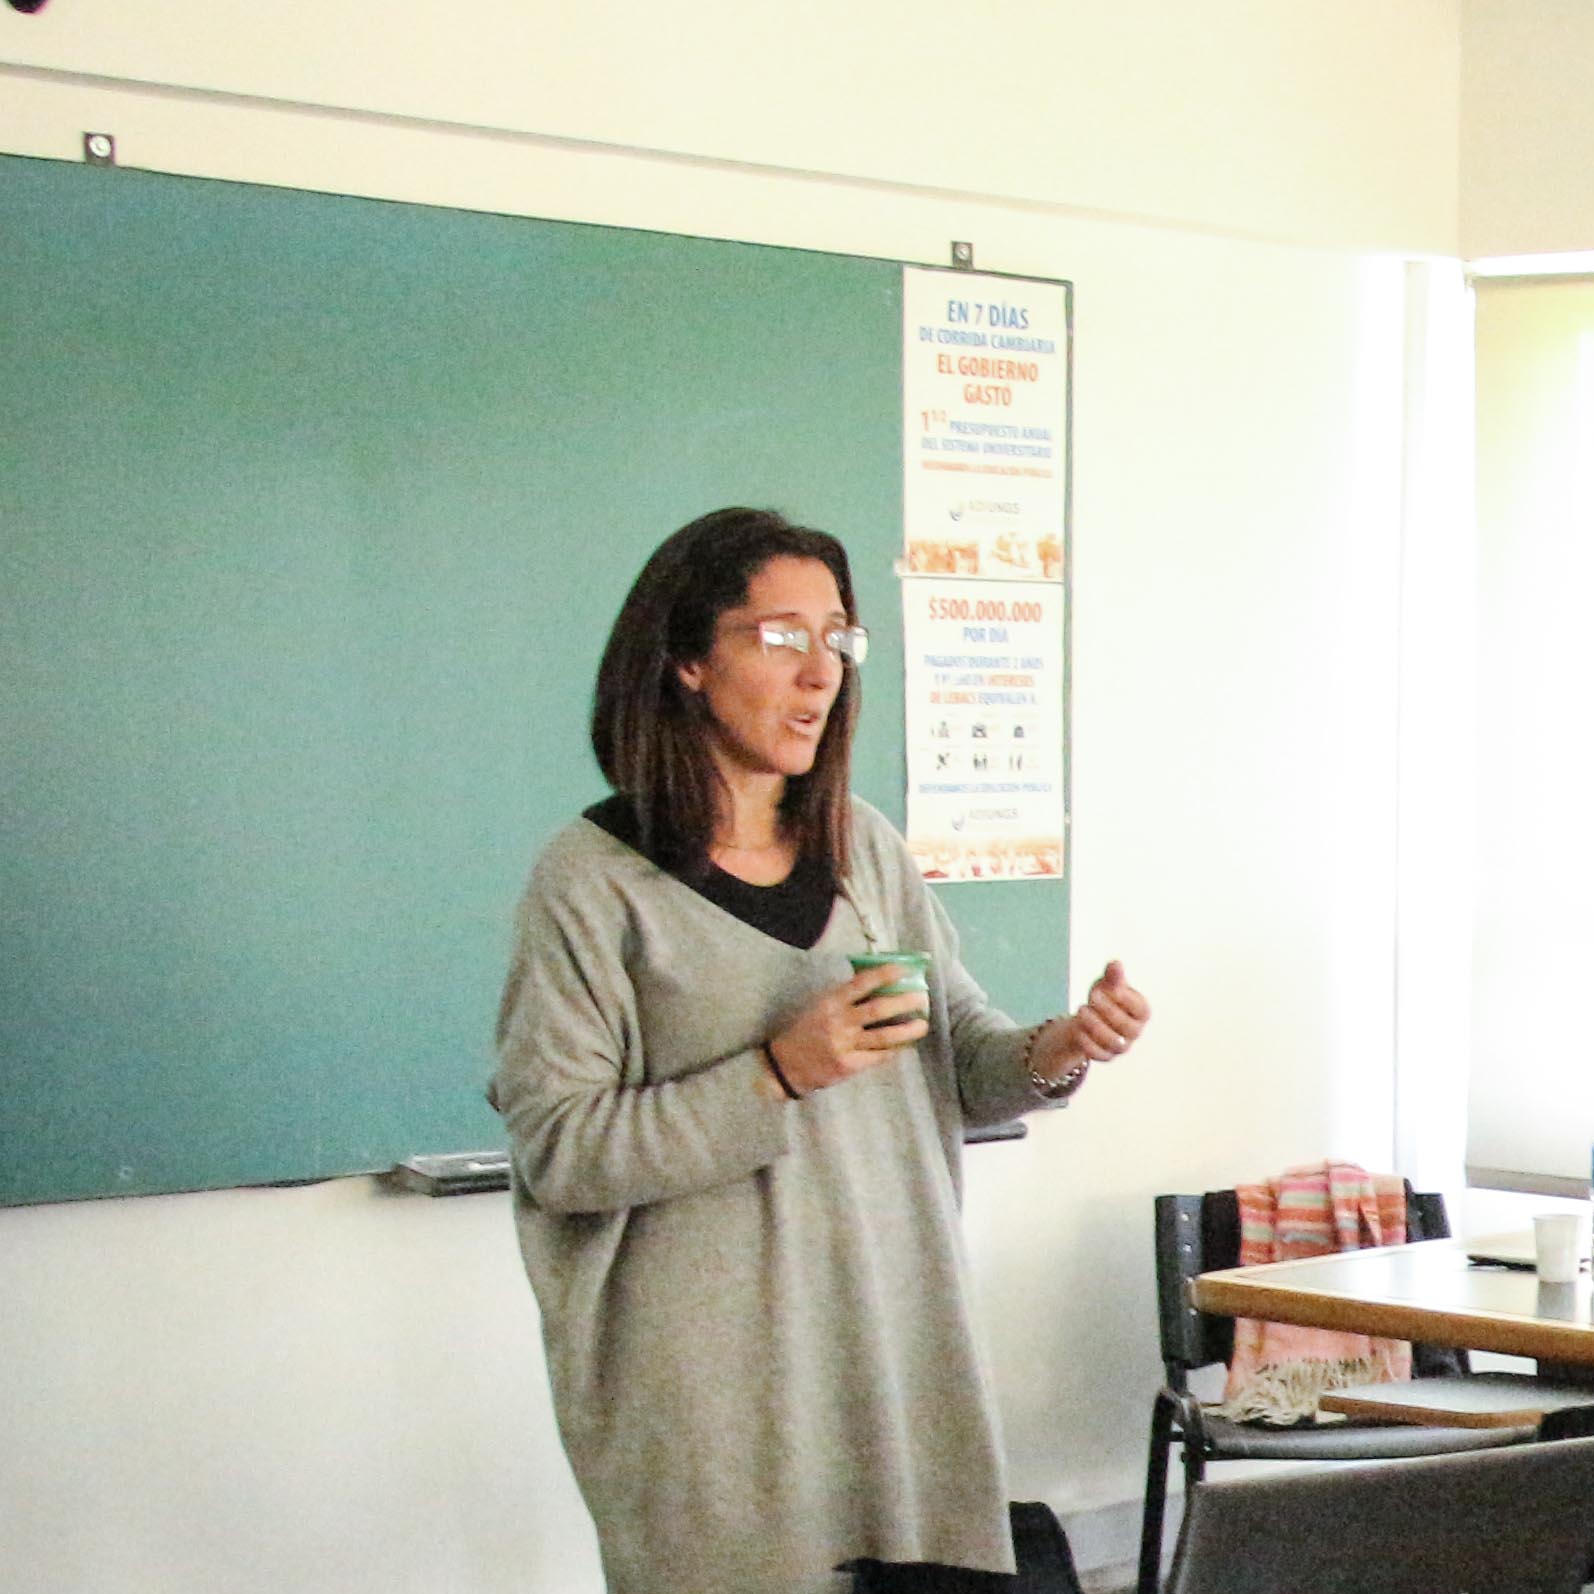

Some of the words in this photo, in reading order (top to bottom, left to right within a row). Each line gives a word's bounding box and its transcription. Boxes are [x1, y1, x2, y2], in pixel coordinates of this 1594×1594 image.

[948, 300, 968, 322] EN
[975, 303, 983, 325] 7
[920, 326, 934, 342] DE
[937, 353, 954, 374] EL
[958, 356, 1039, 382] GOBIERNO
[929, 595, 1042, 622] $500.000.000
